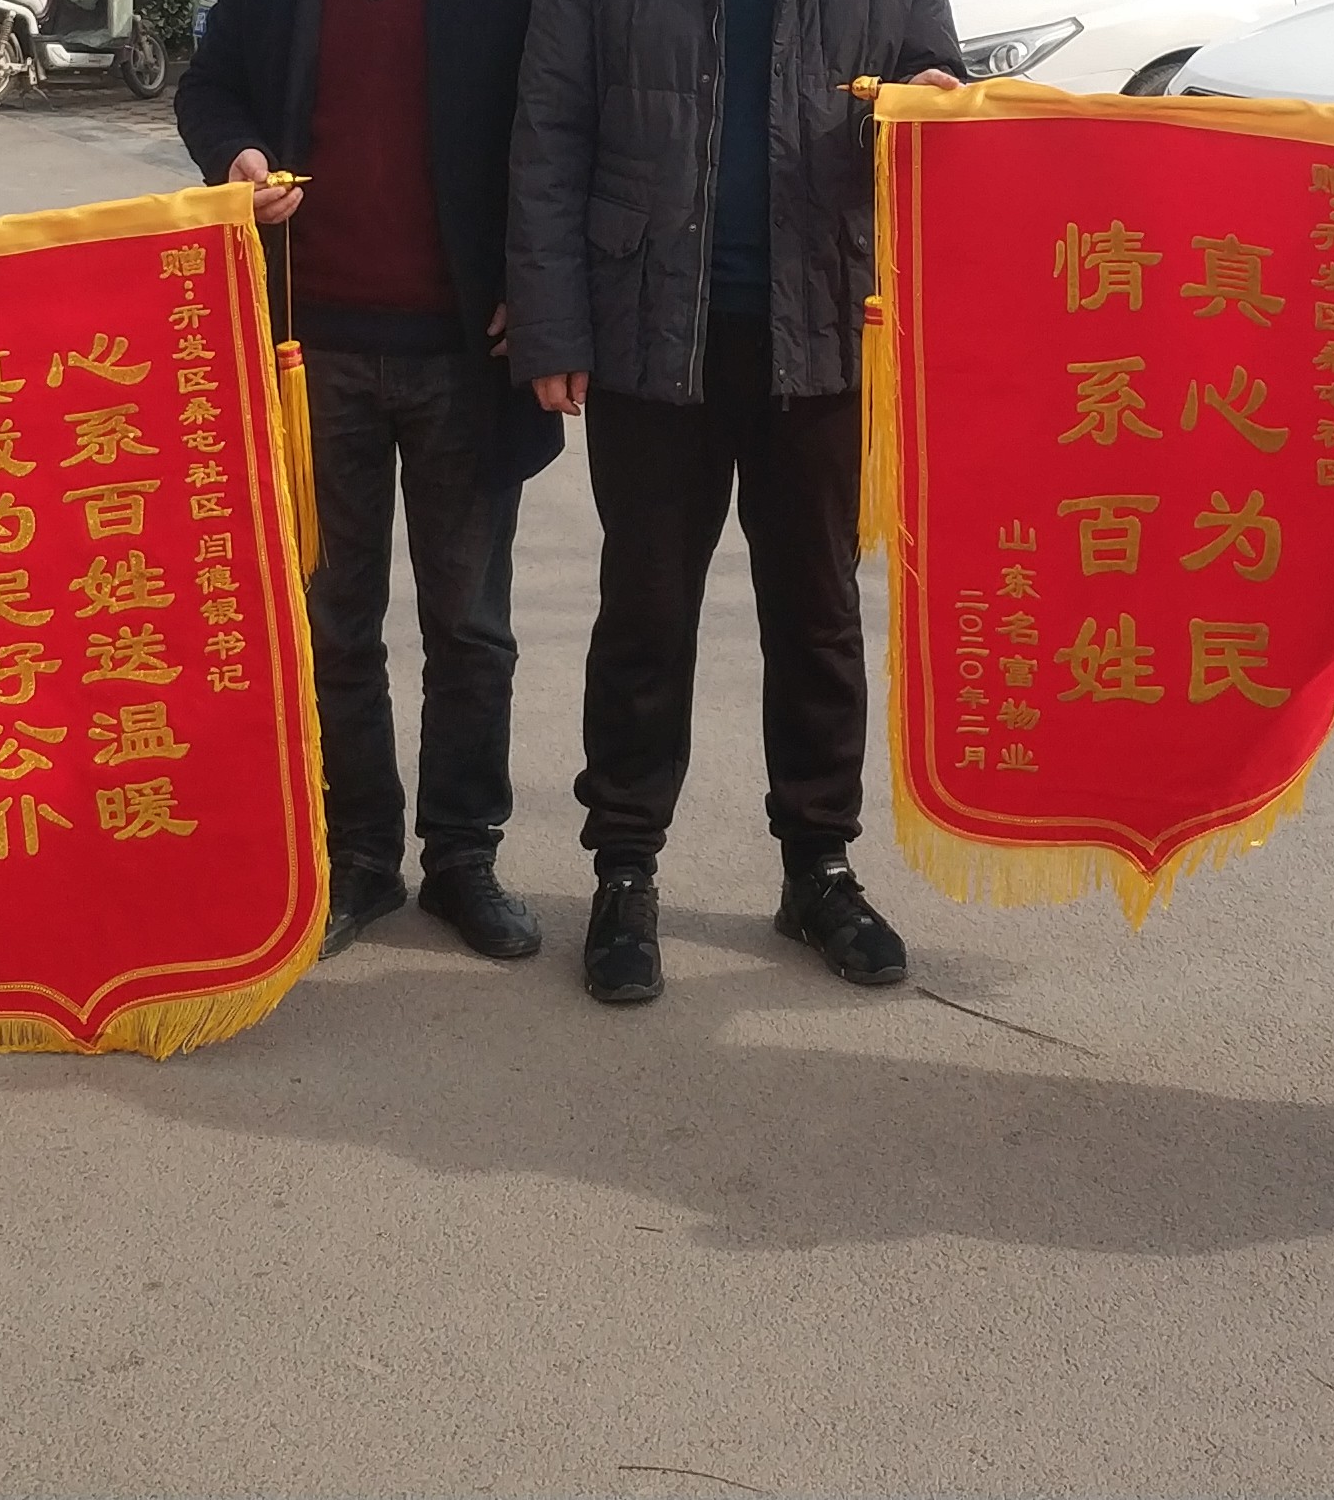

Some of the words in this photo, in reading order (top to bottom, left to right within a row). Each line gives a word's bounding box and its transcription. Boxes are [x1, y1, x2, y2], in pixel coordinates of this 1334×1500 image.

[46, 332, 199, 841] 心系百姓送温暖
[996, 519, 1041, 773] 山东名富物业
[1053, 219, 1165, 705] 情系百姓
[1179, 233, 1291, 708] 真心为民
